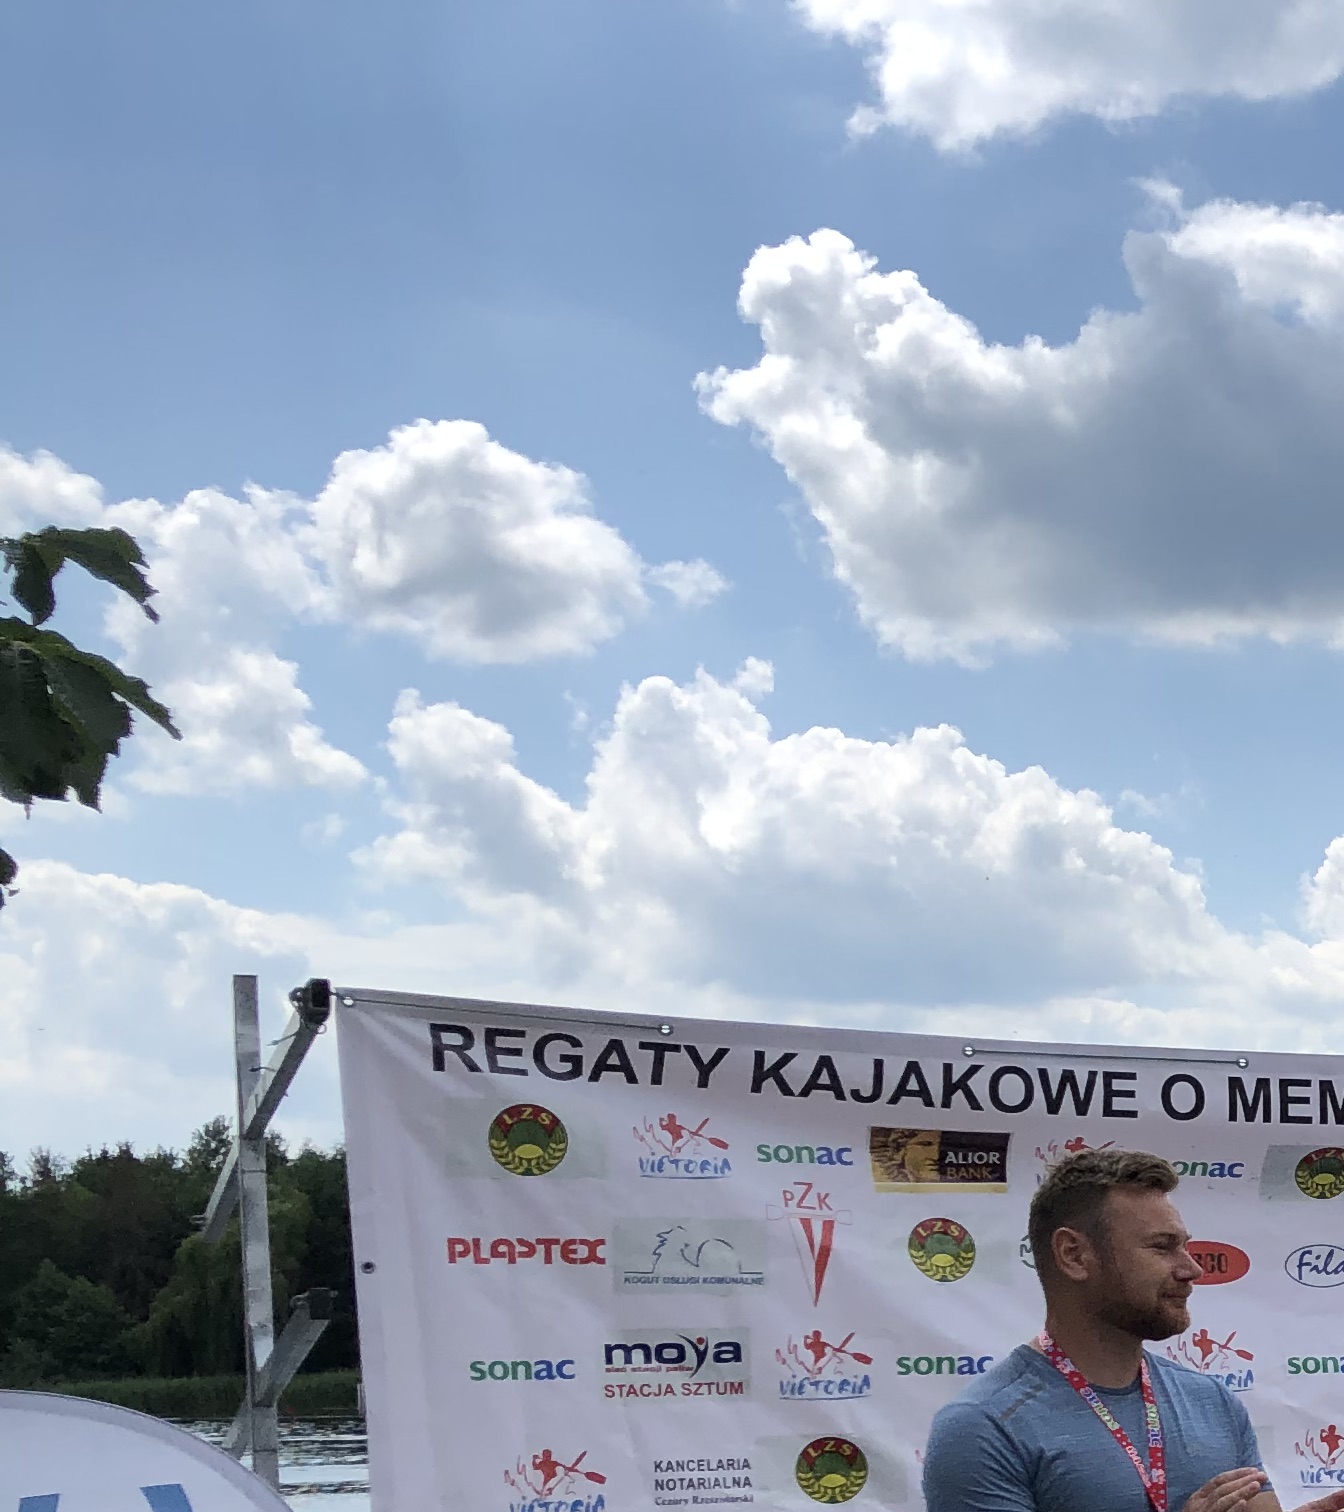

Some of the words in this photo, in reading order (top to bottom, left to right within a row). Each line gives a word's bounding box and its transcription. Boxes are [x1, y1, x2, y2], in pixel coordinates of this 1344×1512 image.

[429, 1022, 730, 1088] REGATY
[750, 1050, 1138, 1118] KAJAKOWE
[1161, 1074, 1205, 1120] O
[503, 1107, 553, 1125] LZS
[757, 1144, 853, 1165] sonac
[945, 1151, 1000, 1164] ALIOR
[946, 1167, 991, 1178] BANK
[1172, 1161, 1244, 1178] onac
[470, 1358, 576, 1381] sonac
[896, 1355, 994, 1376] sonac
[604, 1383, 676, 1398] STACJA
[681, 1381, 744, 1396] SZTUM
[807, 1438, 852, 1457] LZS
[654, 1458, 751, 1473] KANCELARIA
[654, 1476, 752, 1491] NOTARIALNA
